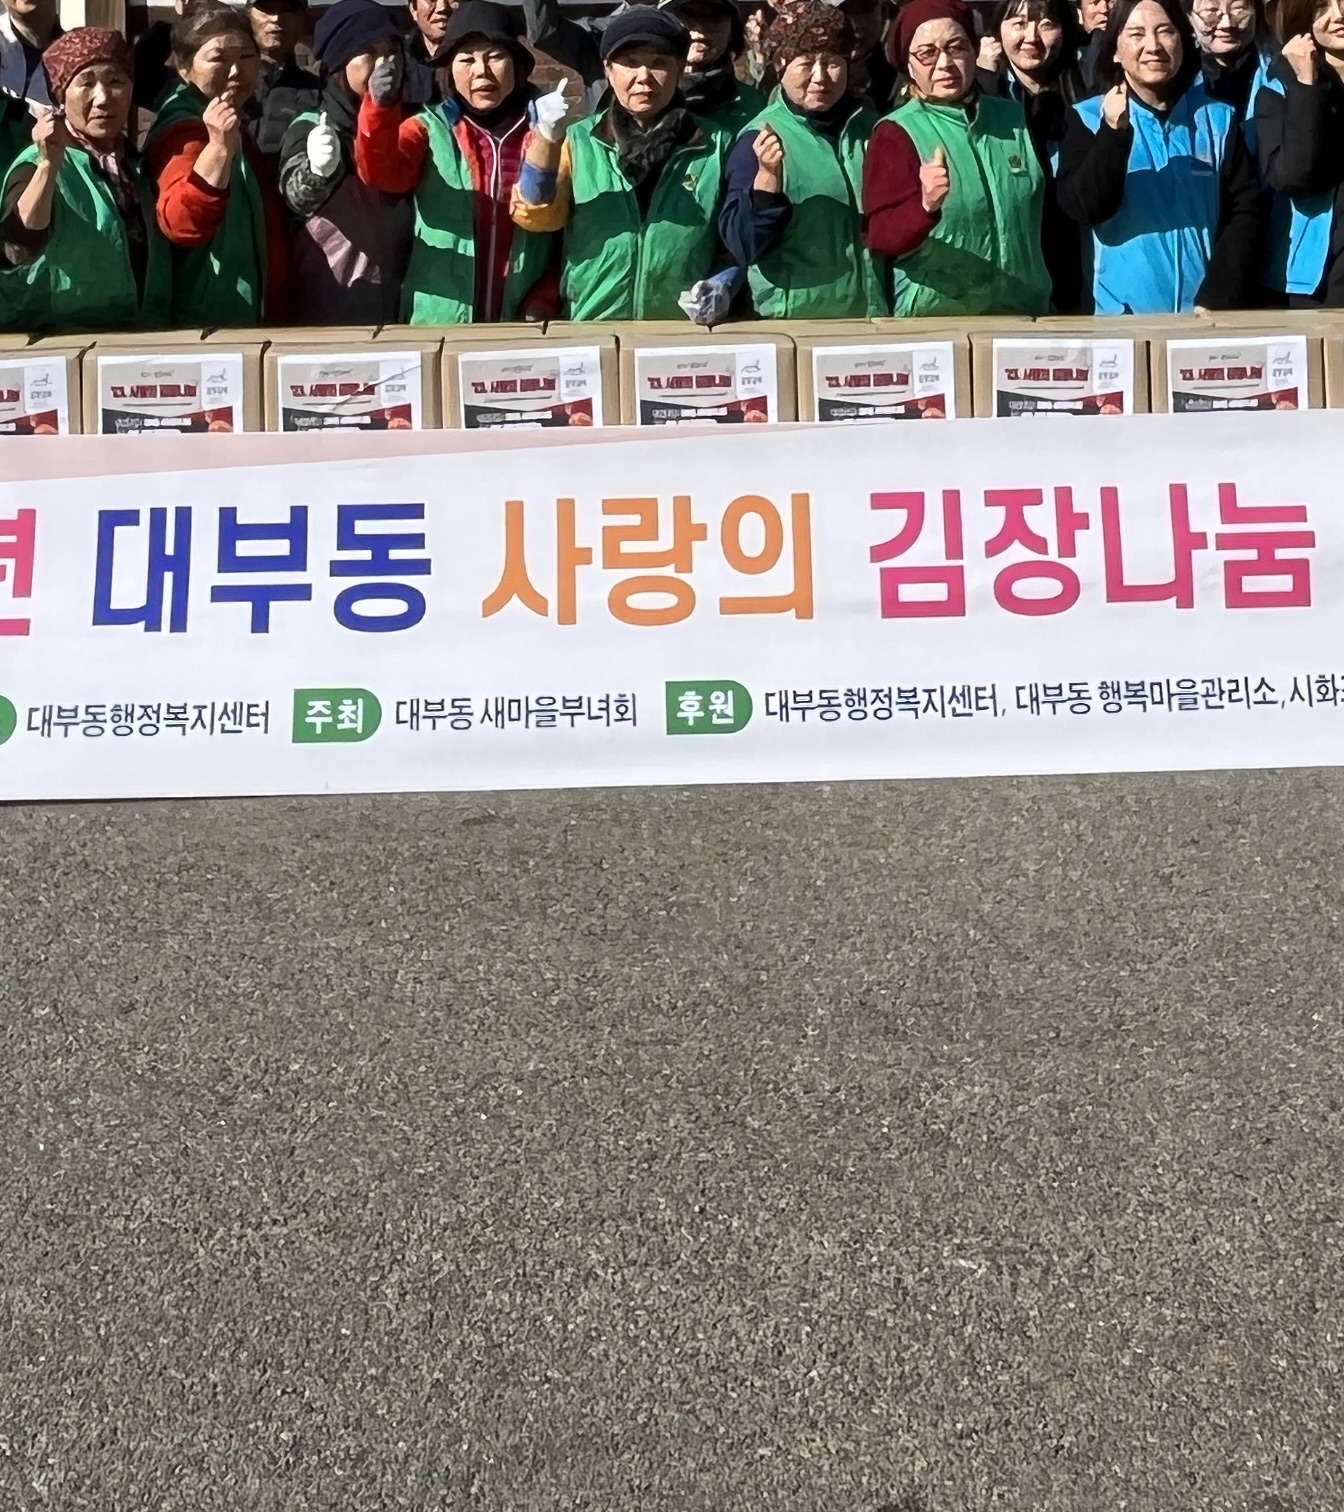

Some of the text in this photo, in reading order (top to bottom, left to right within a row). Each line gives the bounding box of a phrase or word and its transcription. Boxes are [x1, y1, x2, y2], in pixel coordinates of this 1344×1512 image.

[92, 504, 432, 635] 대부동
[482, 493, 815, 626] 사랑의
[869, 483, 1316, 620] 김장나눔
[27, 700, 271, 739] 대부동행정복지센터
[305, 698, 365, 735] 주최
[395, 696, 475, 732] 대부동
[480, 693, 639, 730] 새마을부녀회
[676, 690, 736, 727] 후원
[765, 684, 1007, 724] 대부동행정복지센터,
[1015, 682, 1093, 717] 대부동
